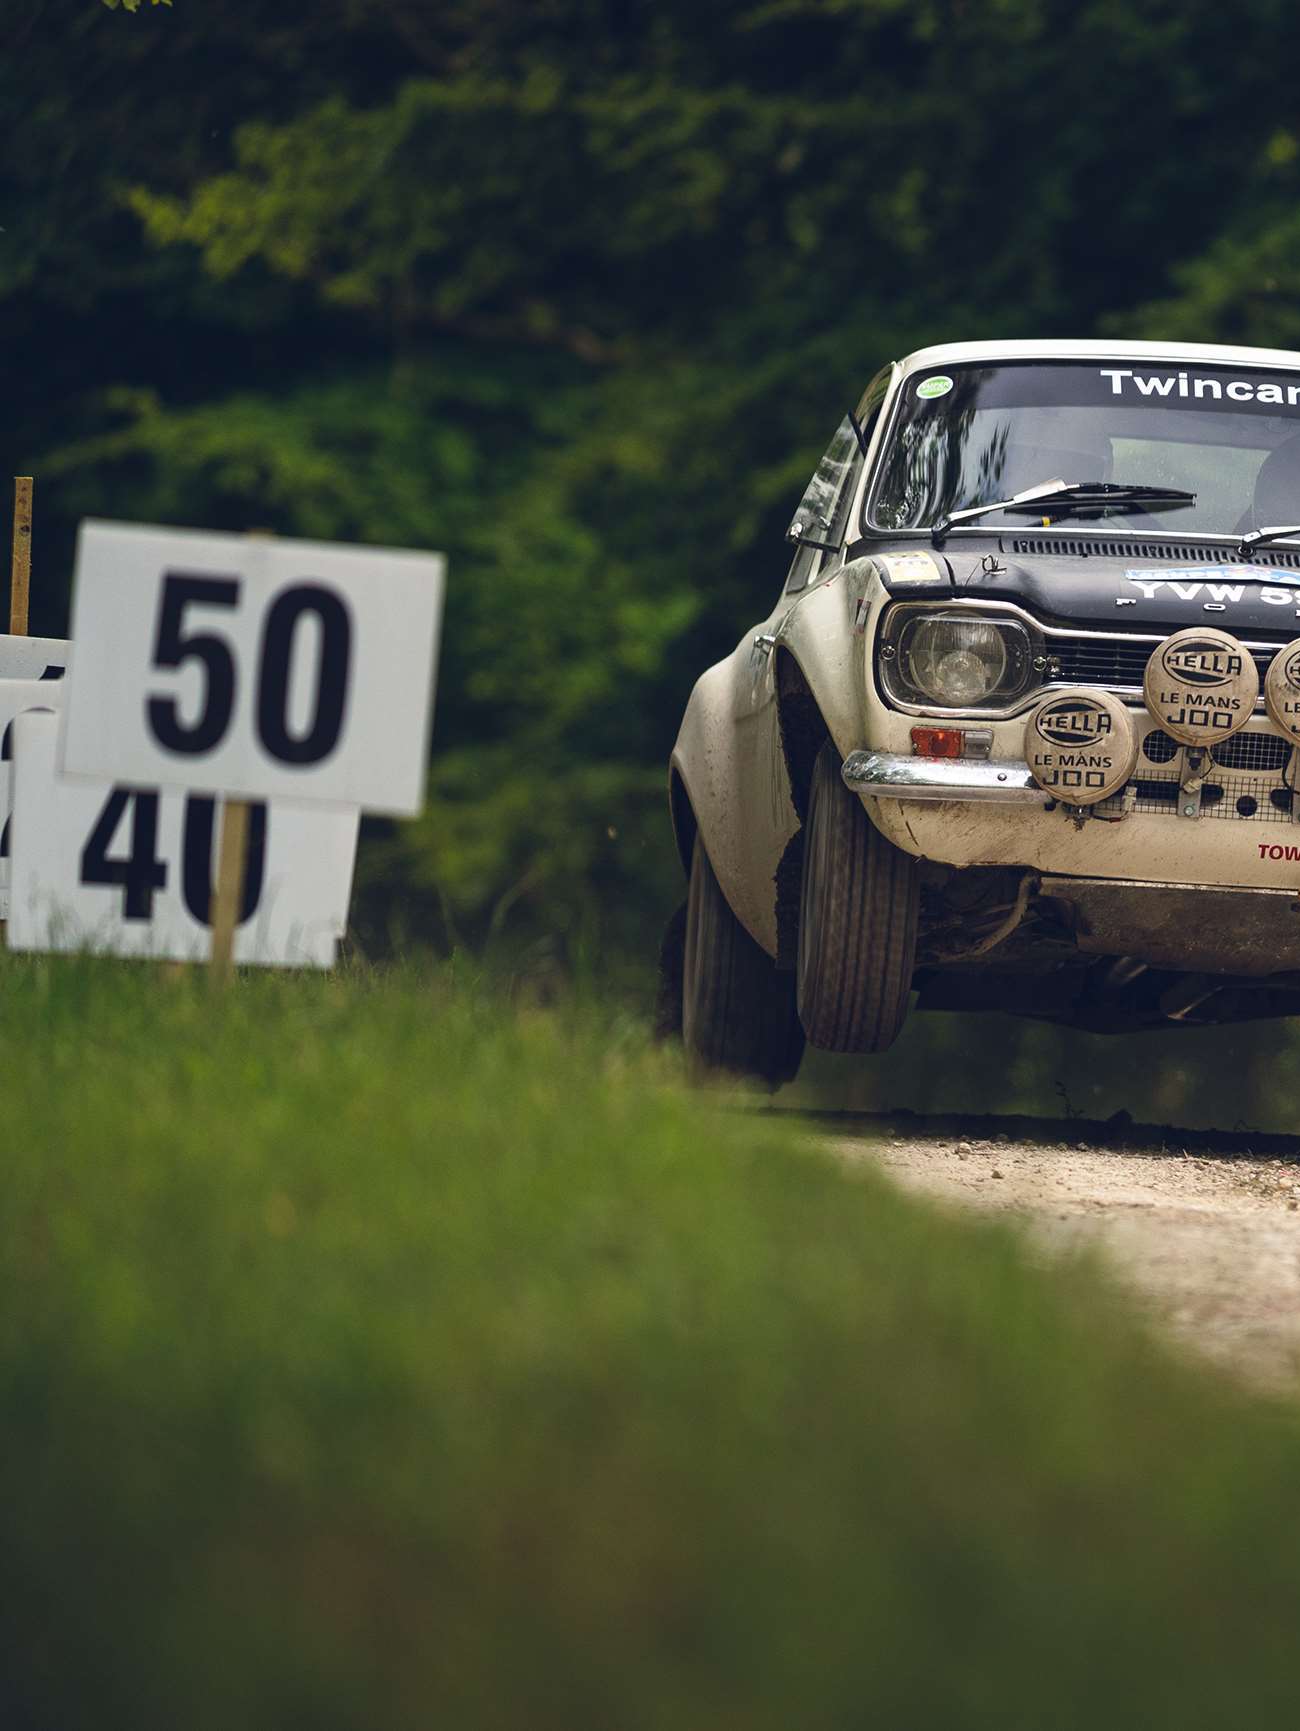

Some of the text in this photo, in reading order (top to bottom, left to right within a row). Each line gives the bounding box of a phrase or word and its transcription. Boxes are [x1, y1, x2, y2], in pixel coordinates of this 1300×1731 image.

[1129, 581, 1246, 602] YVW
[143, 565, 355, 771] 50
[1166, 655, 1242, 676] HELLA
[1160, 692, 1241, 710] LE MANS
[1040, 713, 1112, 734] HELLA
[1034, 754, 1112, 768] LE MANS
